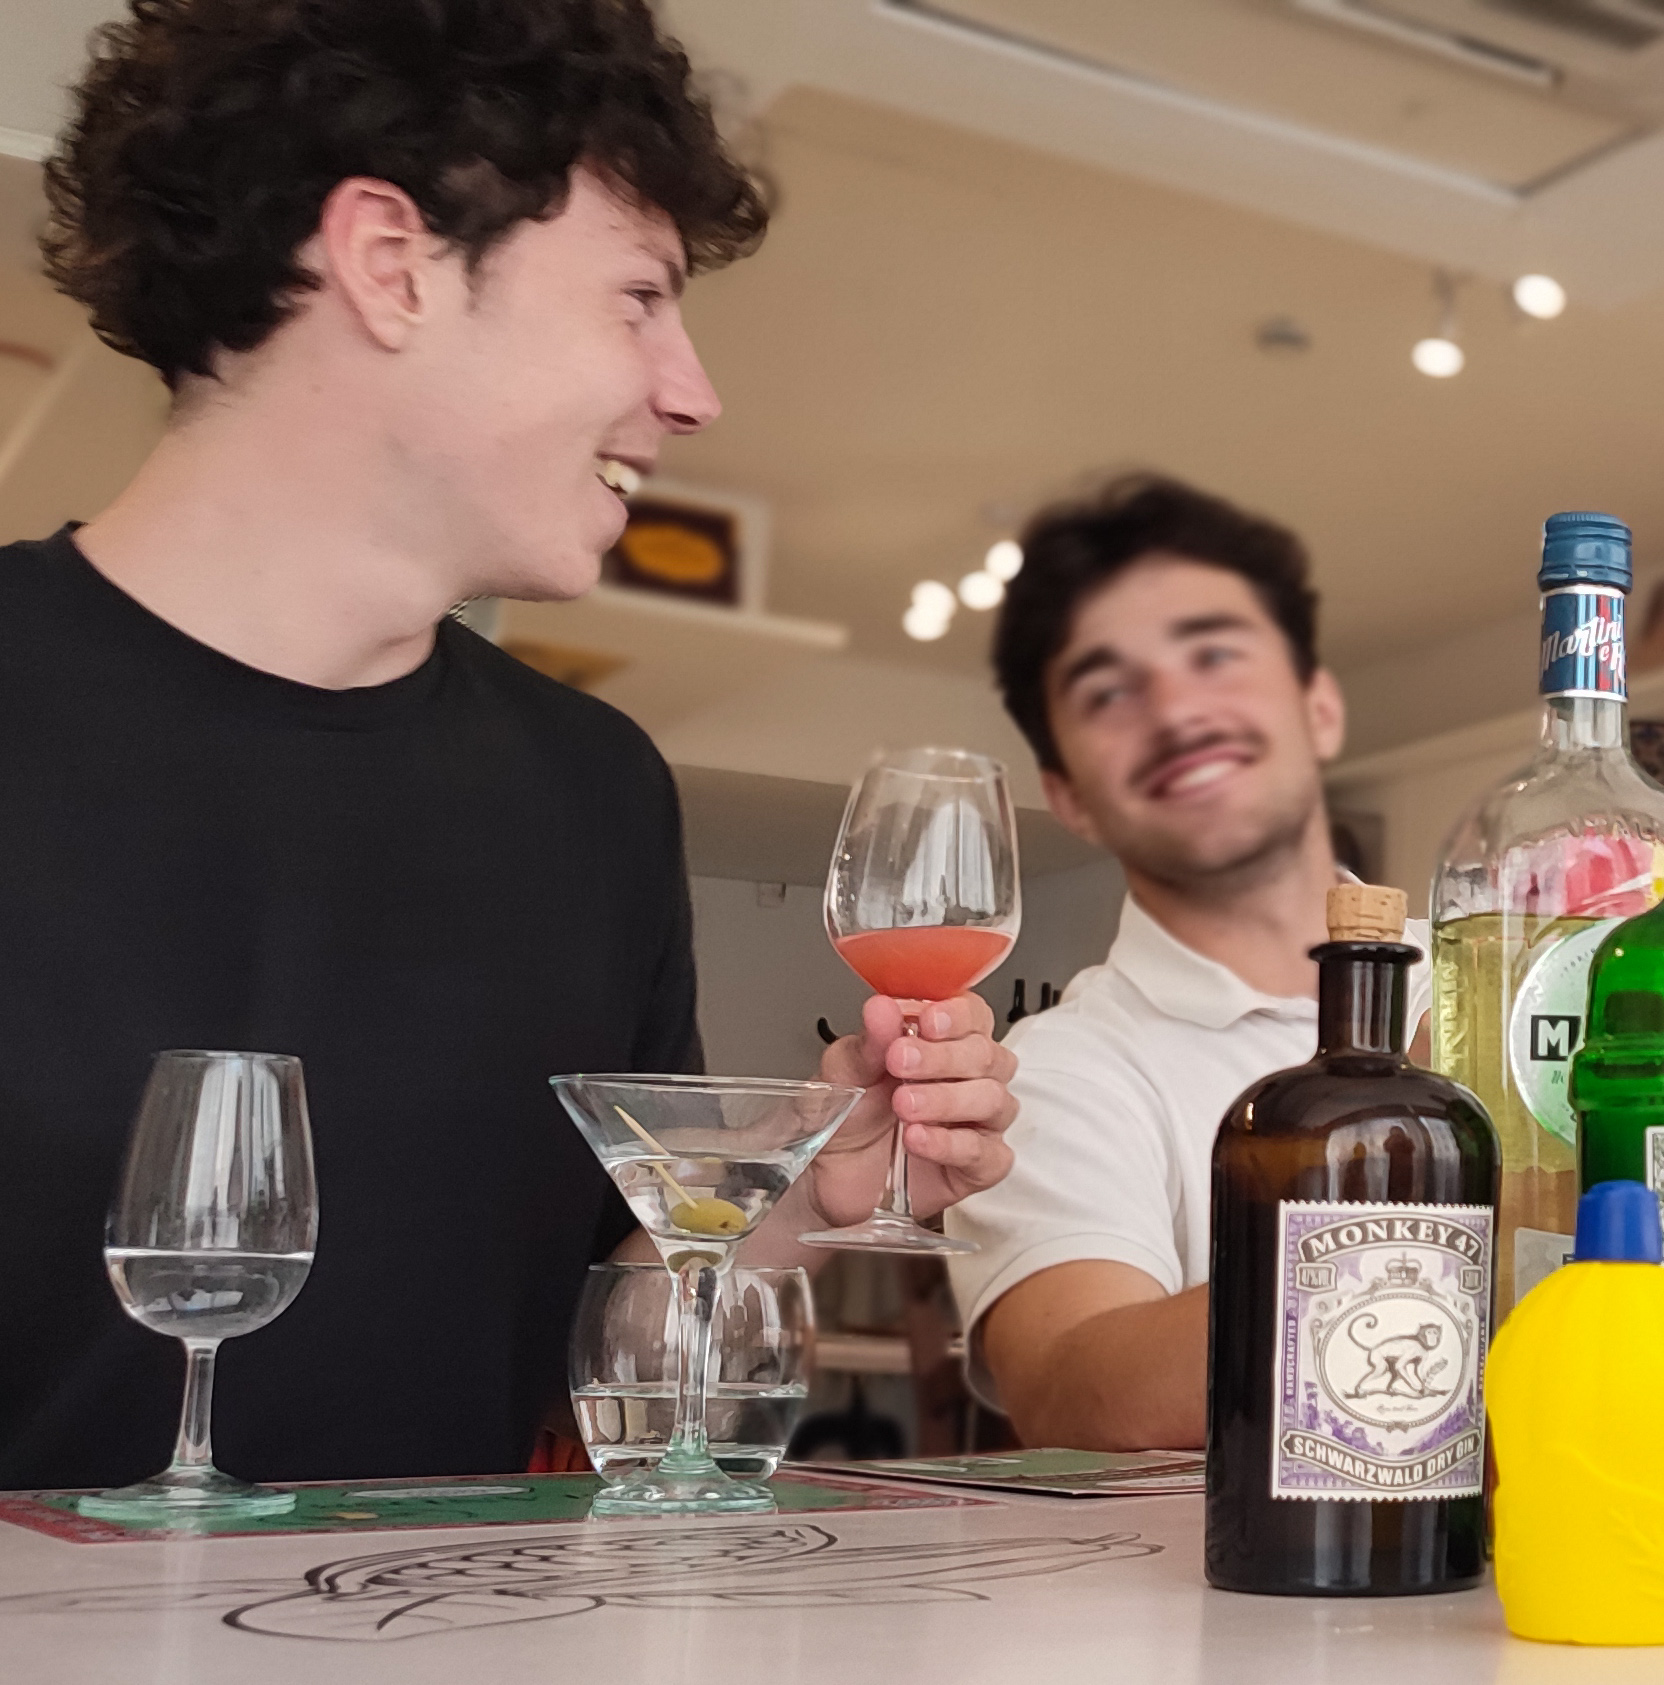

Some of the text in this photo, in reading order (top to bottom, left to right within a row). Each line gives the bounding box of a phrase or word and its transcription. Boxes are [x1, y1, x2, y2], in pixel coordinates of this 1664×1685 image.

[1541, 615, 1622, 672] Martini
[1308, 1220, 1479, 1257] MONKEY 47
[1294, 1436, 1475, 1485] SCHWARZWALD DRY GIN
